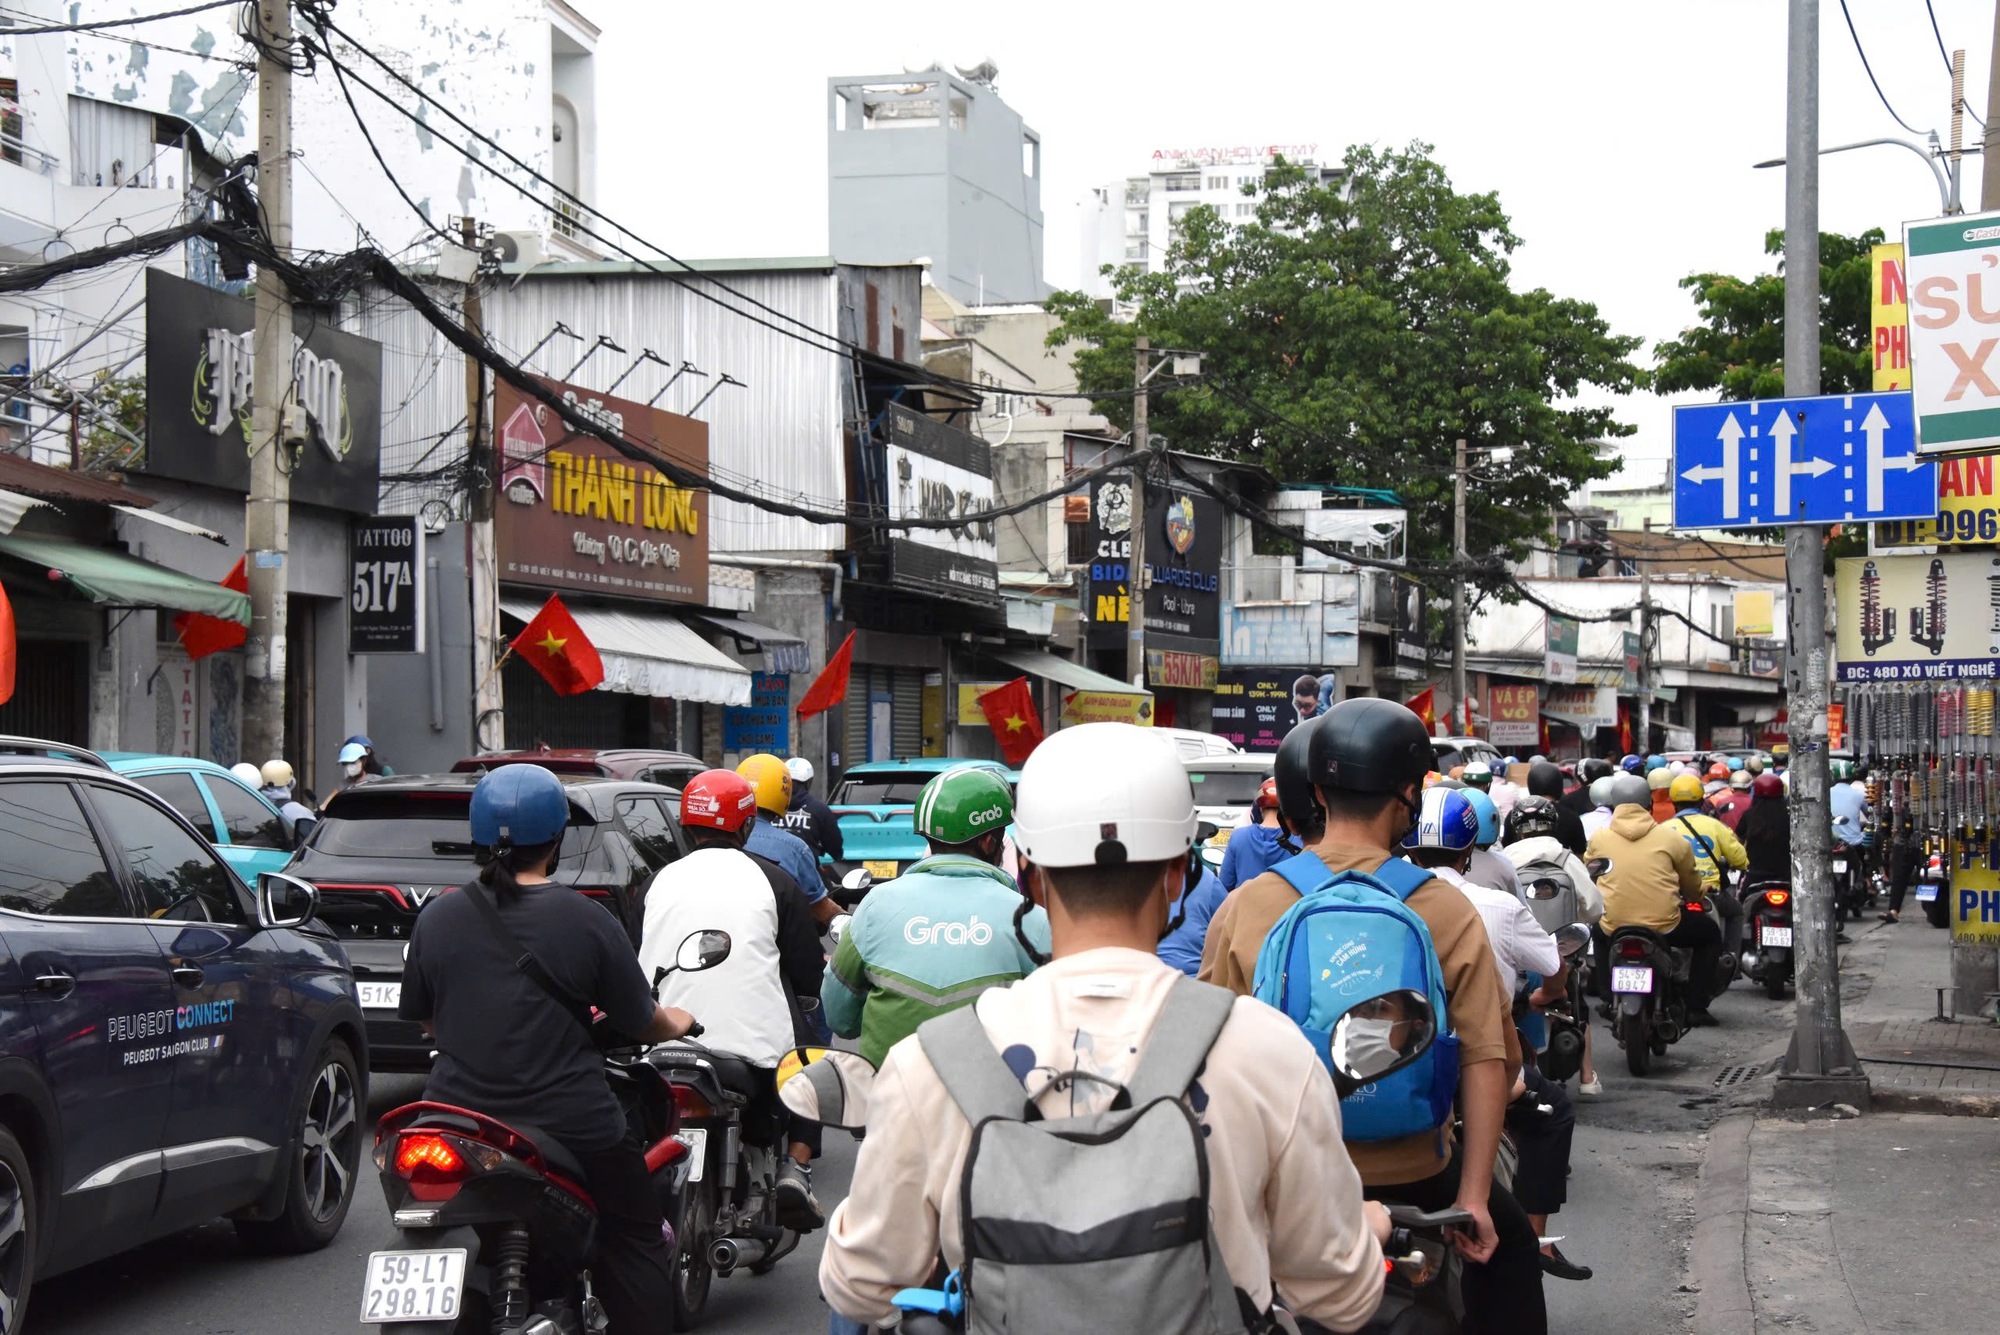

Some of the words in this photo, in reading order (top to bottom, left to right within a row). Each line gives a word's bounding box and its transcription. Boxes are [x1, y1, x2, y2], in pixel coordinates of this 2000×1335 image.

[1938, 507, 2000, 543] 096
[356, 528, 412, 547] TATTOO
[1092, 564, 1131, 581] BID
[1193, 571, 1217, 592] CLUB
[1163, 594, 1177, 612] Pool
[1180, 596, 1195, 615] Libre
[1163, 652, 1201, 687] 55K/H
[1847, 667, 1870, 679] ĐC:
[1873, 666, 1899, 679] 480
[1902, 663, 1921, 679] XÔ
[1925, 661, 1954, 678] VIẾT
[1958, 661, 1996, 678] NGHỆ
[1256, 682, 1278, 690] ONLY
[1495, 687, 1512, 704] VÁ
[1517, 687, 1536, 704] ÉP
[1256, 705, 1277, 713] ONLY
[968, 804, 1003, 826] Grab
[903, 915, 993, 946] Grab
[1957, 932, 1976, 943] 480
[1618, 969, 1647, 980] 54-S7
[1618, 980, 1646, 991] 0947
[107, 1009, 174, 1042] PEUGEOT
[176, 999, 235, 1030] CONNECT
[123, 1048, 160, 1066] PEUGEOT
[161, 1042, 190, 1060] SAIGON
[191, 1037, 209, 1052] CLUB
[661, 1051, 698, 1059] HONDA
[382, 1255, 448, 1285] 59-L1
[367, 1286, 456, 1317] 298.16
